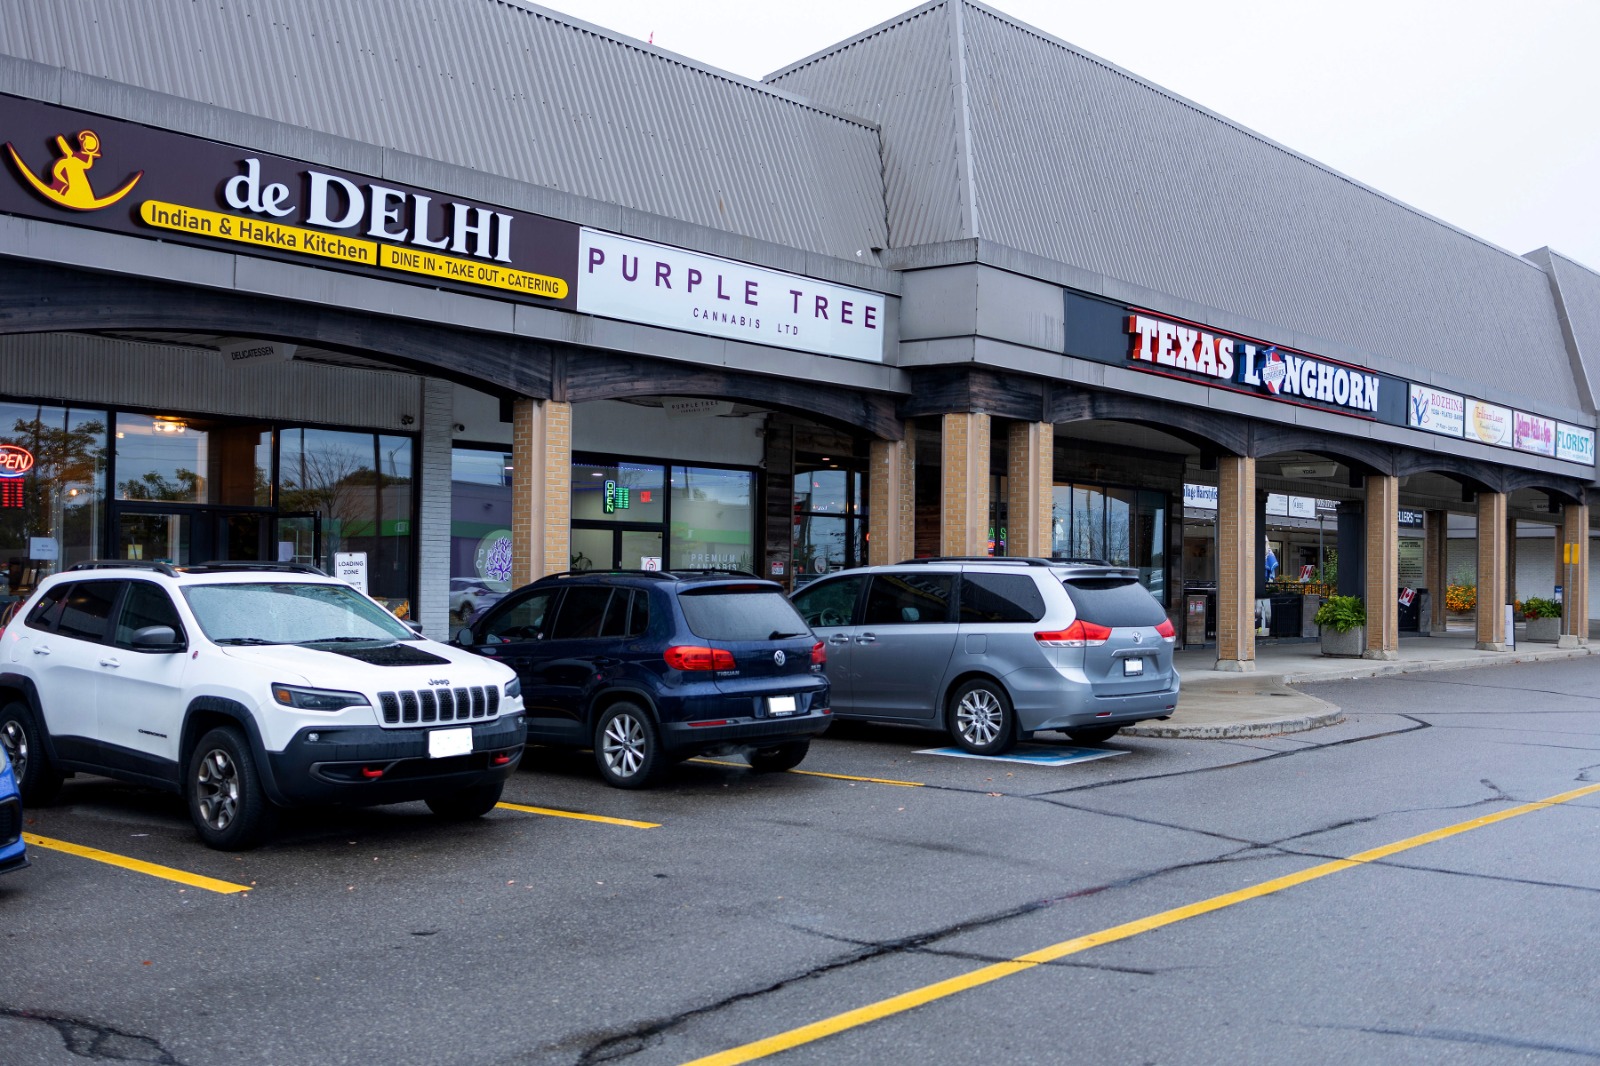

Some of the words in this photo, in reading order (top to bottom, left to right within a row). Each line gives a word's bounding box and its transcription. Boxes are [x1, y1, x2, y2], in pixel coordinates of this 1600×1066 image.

[225, 158, 296, 217] de
[306, 170, 514, 264] DELHI
[151, 204, 212, 232] Indian
[219, 217, 232, 236] &
[239, 220, 297, 248] Hakka
[303, 232, 368, 261] Kitchen
[391, 250, 420, 269] DINE
[423, 257, 436, 272] IN
[445, 261, 475, 279] TAKE
[477, 267, 500, 283] OUT
[508, 273, 559, 294] CATERING
[588, 247, 759, 307] PURPLE
[789, 289, 877, 330] TREE
[693, 307, 761, 330] CANNABIS
[777, 323, 799, 336] LTD
[231, 345, 274, 361] DELICATESSEN
[1130, 315, 1234, 379] TEXAS
[1243, 344, 1380, 412] LNGHORN
[1431, 393, 1464, 413] ROZHINA
[1557, 430, 1589, 454] FLORIST
[0, 454, 28, 469] PEN
[606, 482, 614, 513] OPEN
[1398, 511, 1414, 524] LLERS
[690, 553, 736, 562] PREMIUM
[428, 678, 450, 687] Jeep
